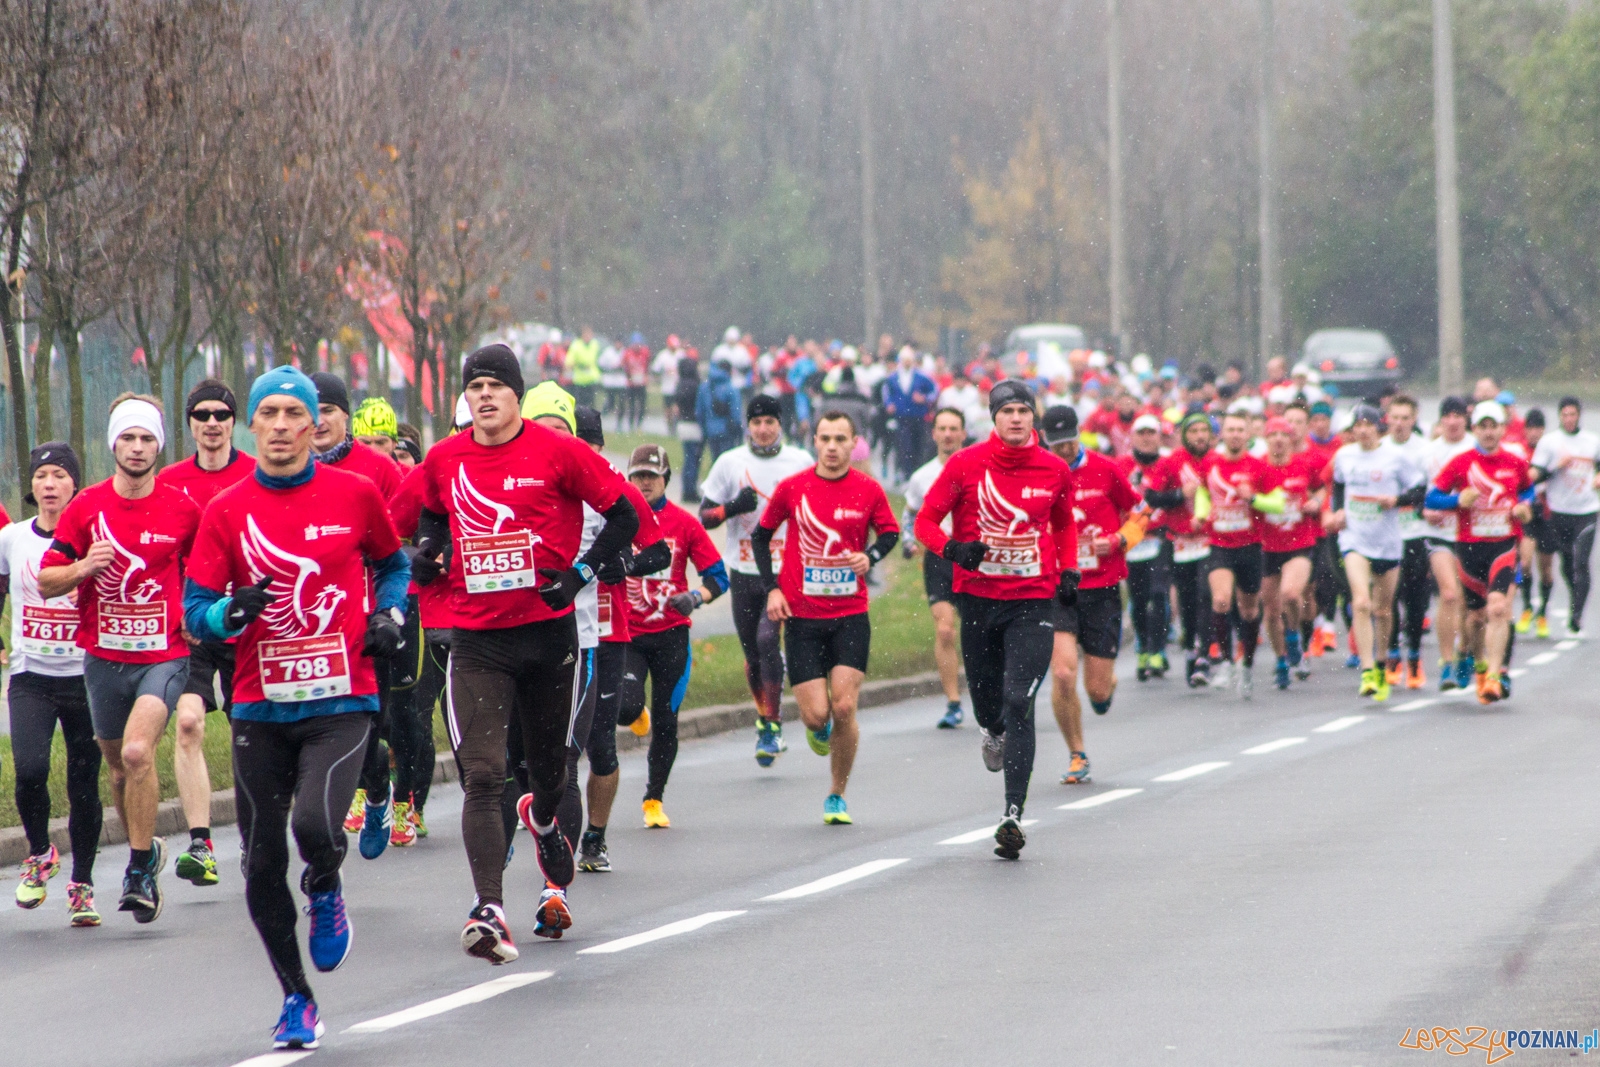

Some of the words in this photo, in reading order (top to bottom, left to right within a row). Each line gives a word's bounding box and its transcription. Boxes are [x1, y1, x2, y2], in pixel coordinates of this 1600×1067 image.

[470, 551, 525, 574] 8455
[988, 549, 1033, 564] 7322
[811, 569, 851, 583] 8607
[29, 621, 78, 640] 7617
[108, 618, 159, 636] 3399
[278, 656, 330, 681] 798
